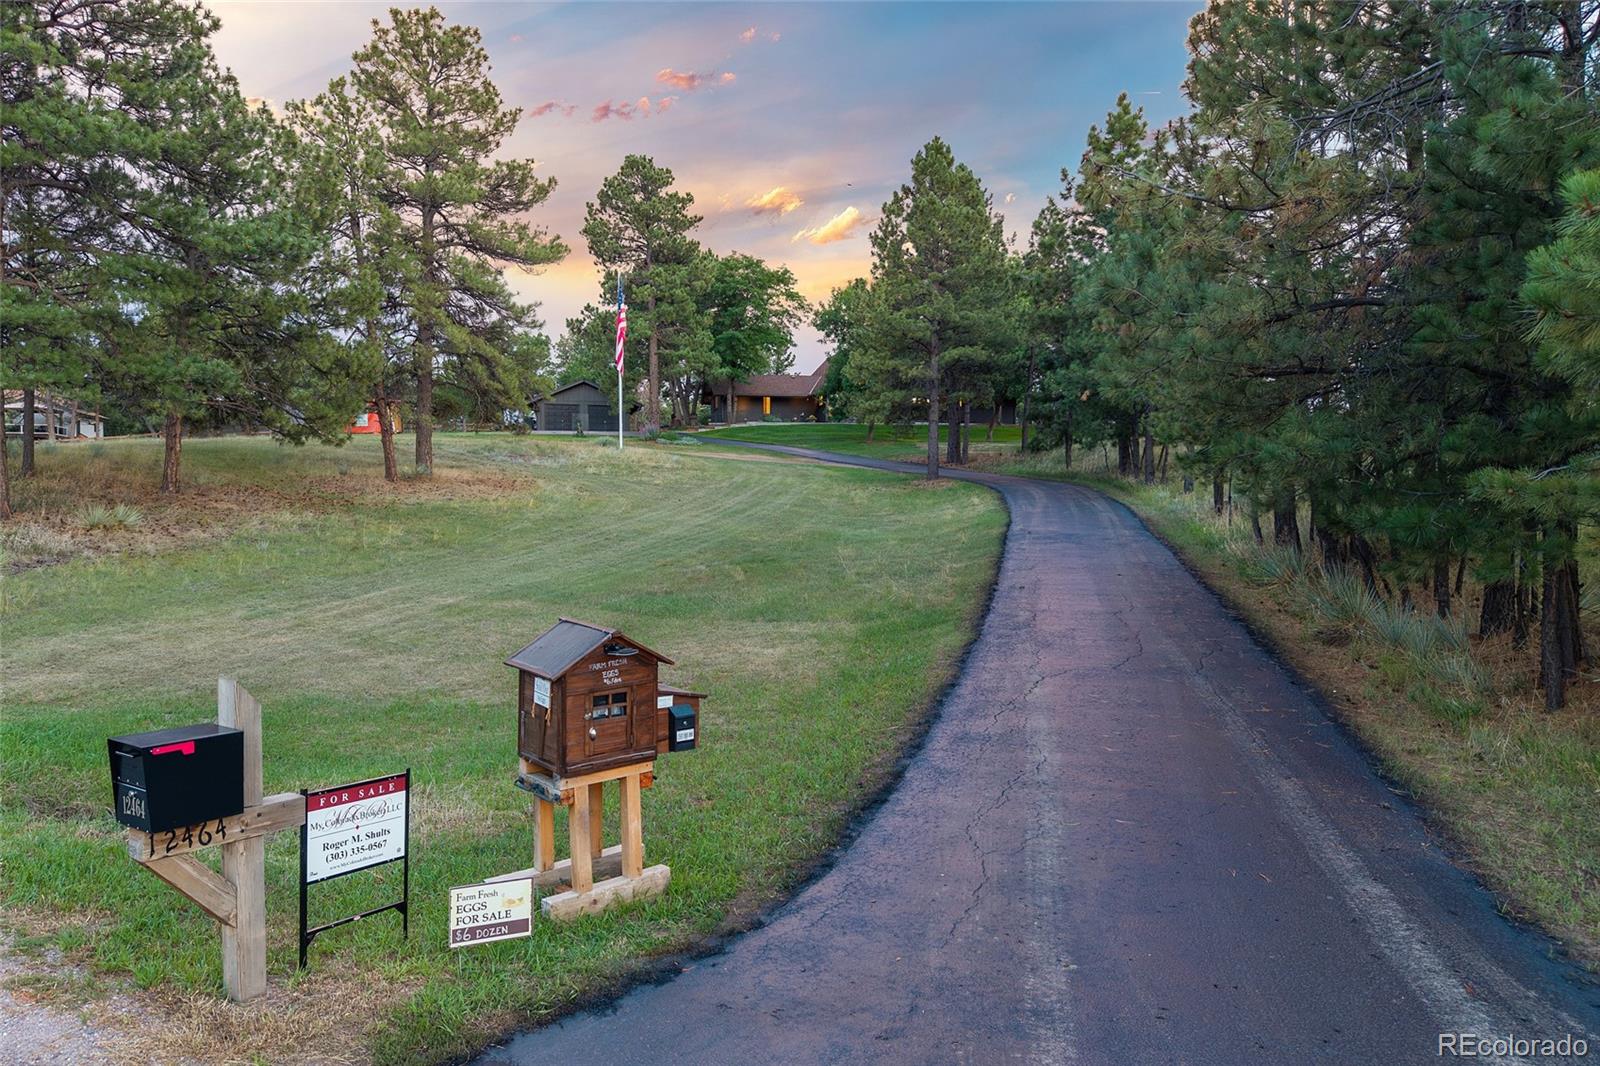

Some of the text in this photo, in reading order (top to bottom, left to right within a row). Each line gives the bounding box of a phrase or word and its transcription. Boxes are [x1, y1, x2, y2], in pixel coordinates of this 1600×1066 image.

[588, 658, 628, 671] FARM FRESH
[602, 669, 619, 678] EGGS
[320, 783, 395, 806] FOR SALE
[122, 795, 145, 819] 12464
[149, 817, 227, 858] 12464
[322, 828, 391, 851] Roger M. Shults
[325, 839, 388, 864] (303) 335-0567
[456, 889, 498, 902] Farm Fresh
[456, 901, 487, 914] EGGS
[456, 909, 512, 926] FOR SALE
[455, 925, 508, 941] $6 DOZEN
